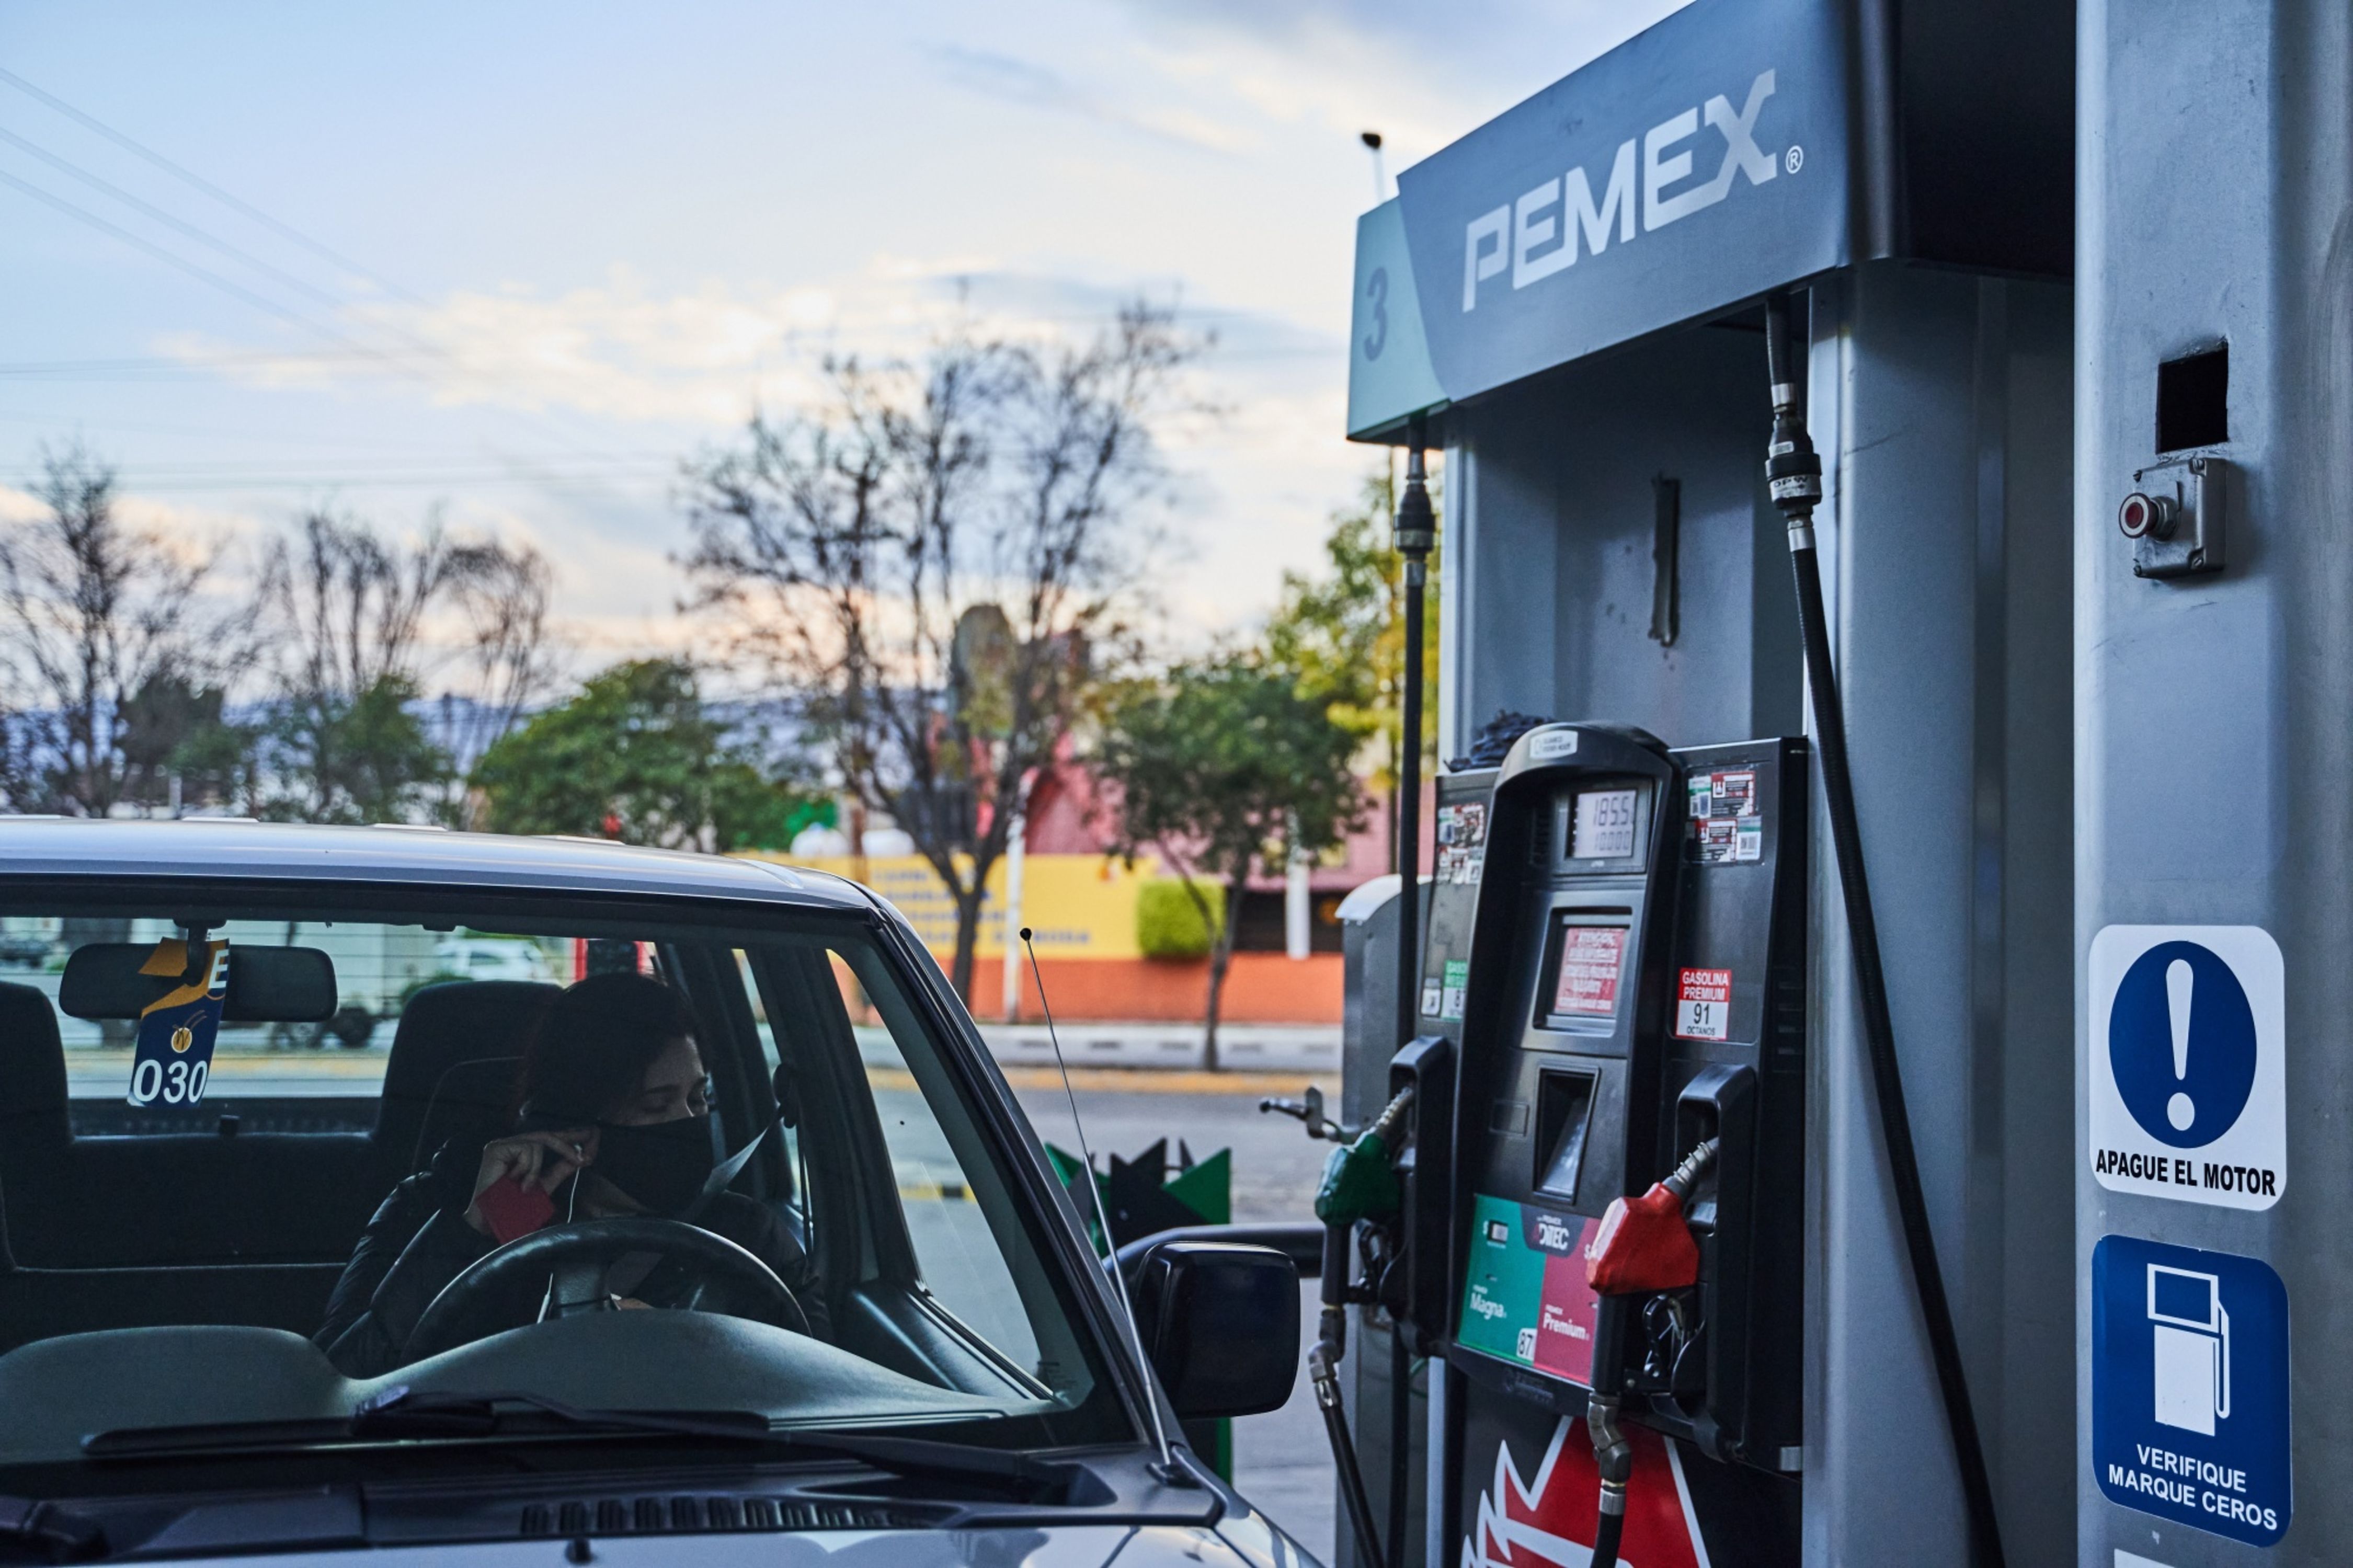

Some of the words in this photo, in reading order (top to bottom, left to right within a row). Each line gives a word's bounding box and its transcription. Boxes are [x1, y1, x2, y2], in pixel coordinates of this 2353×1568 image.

[1463, 68, 1777, 313] PEMEX
[1363, 267, 1388, 362] 3
[208, 949, 229, 989] E
[1682, 971, 1729, 986] GASOLINA
[1683, 986, 1726, 1001] PREMIUM
[1686, 1025, 1716, 1036] OCTANOS
[1694, 1003, 1710, 1025] 91
[133, 1059, 208, 1103] 030
[2096, 1149, 2168, 1183] APAGUE
[2175, 1159, 2198, 1186] EL
[2204, 1163, 2276, 1197] MOTOR
[1470, 1292, 1504, 1320] Magna
[1543, 1312, 1586, 1340] Premium
[1518, 1332, 1533, 1356] 87
[2137, 1443, 2247, 1493] VERIFIQUE
[2109, 1463, 2196, 1508] MARQUE
[2202, 1491, 2278, 1531] CEROS
